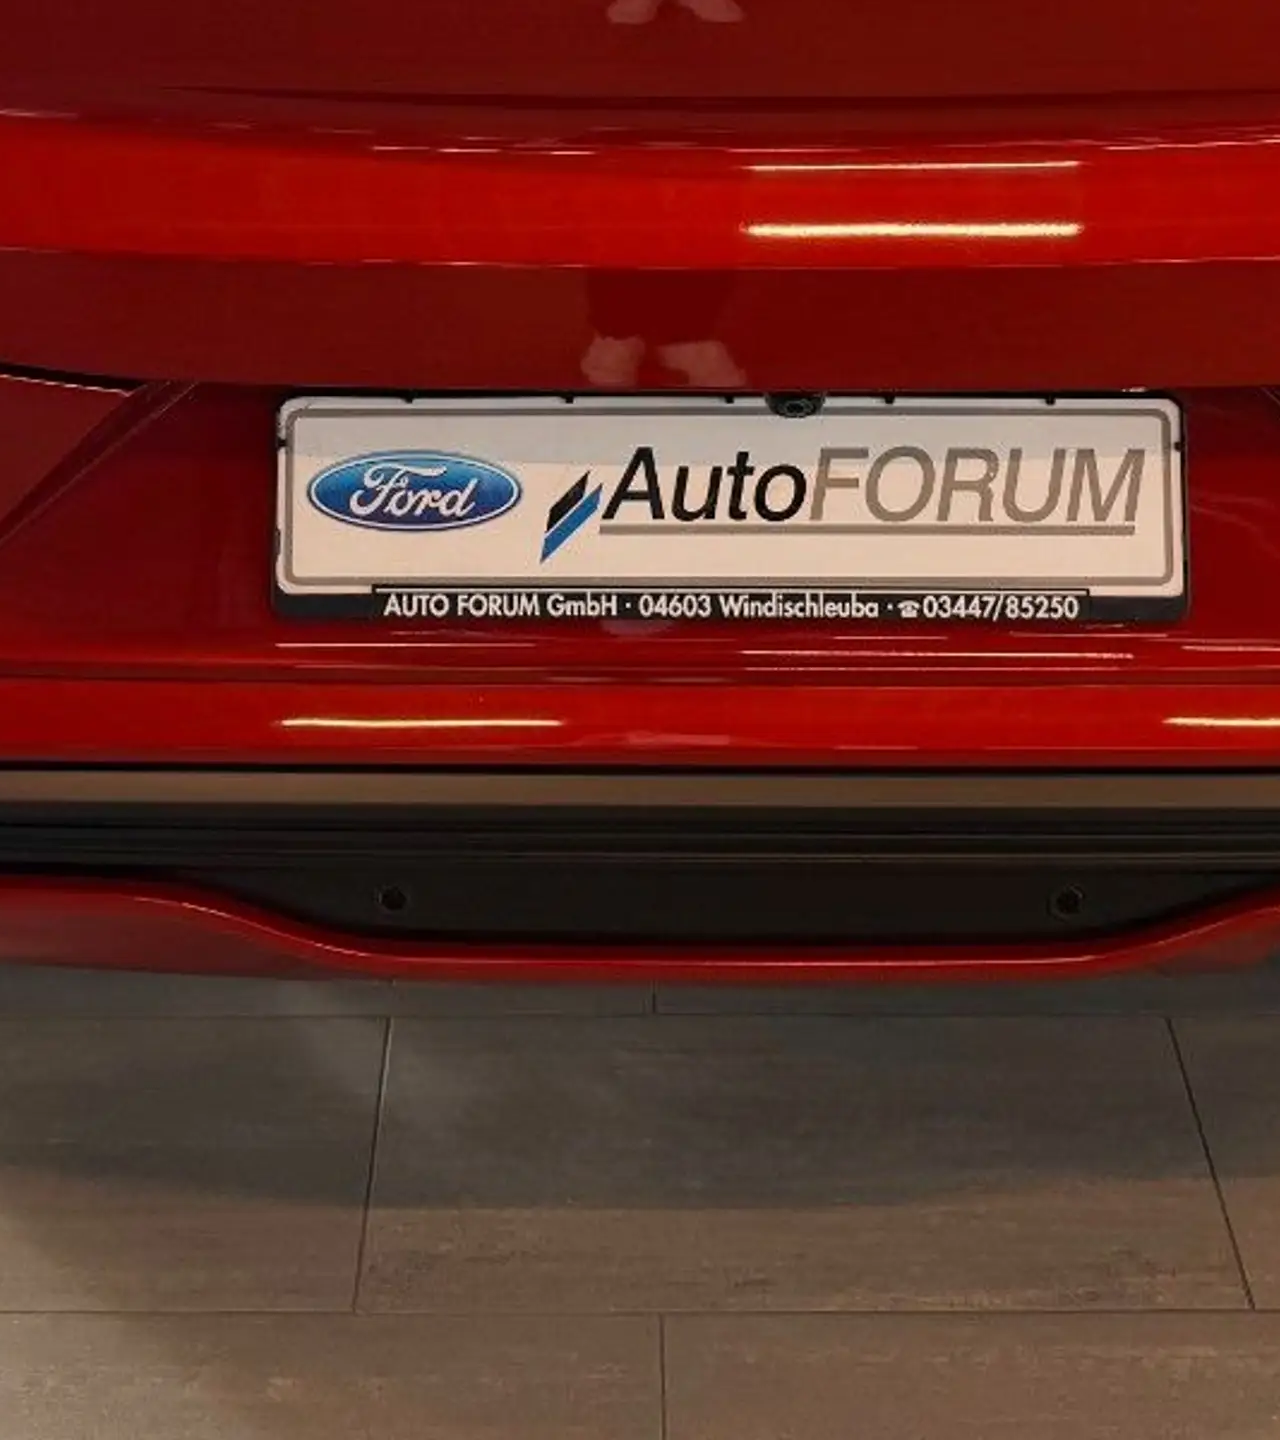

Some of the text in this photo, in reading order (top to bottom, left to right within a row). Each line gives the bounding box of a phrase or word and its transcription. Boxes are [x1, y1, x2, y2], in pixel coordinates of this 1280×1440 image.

[349, 445, 1146, 523] Ford AutoFORUM
[382, 591, 1080, 621] AUTO FORUM GmbH 04603 Windischleuba 03447/85250
